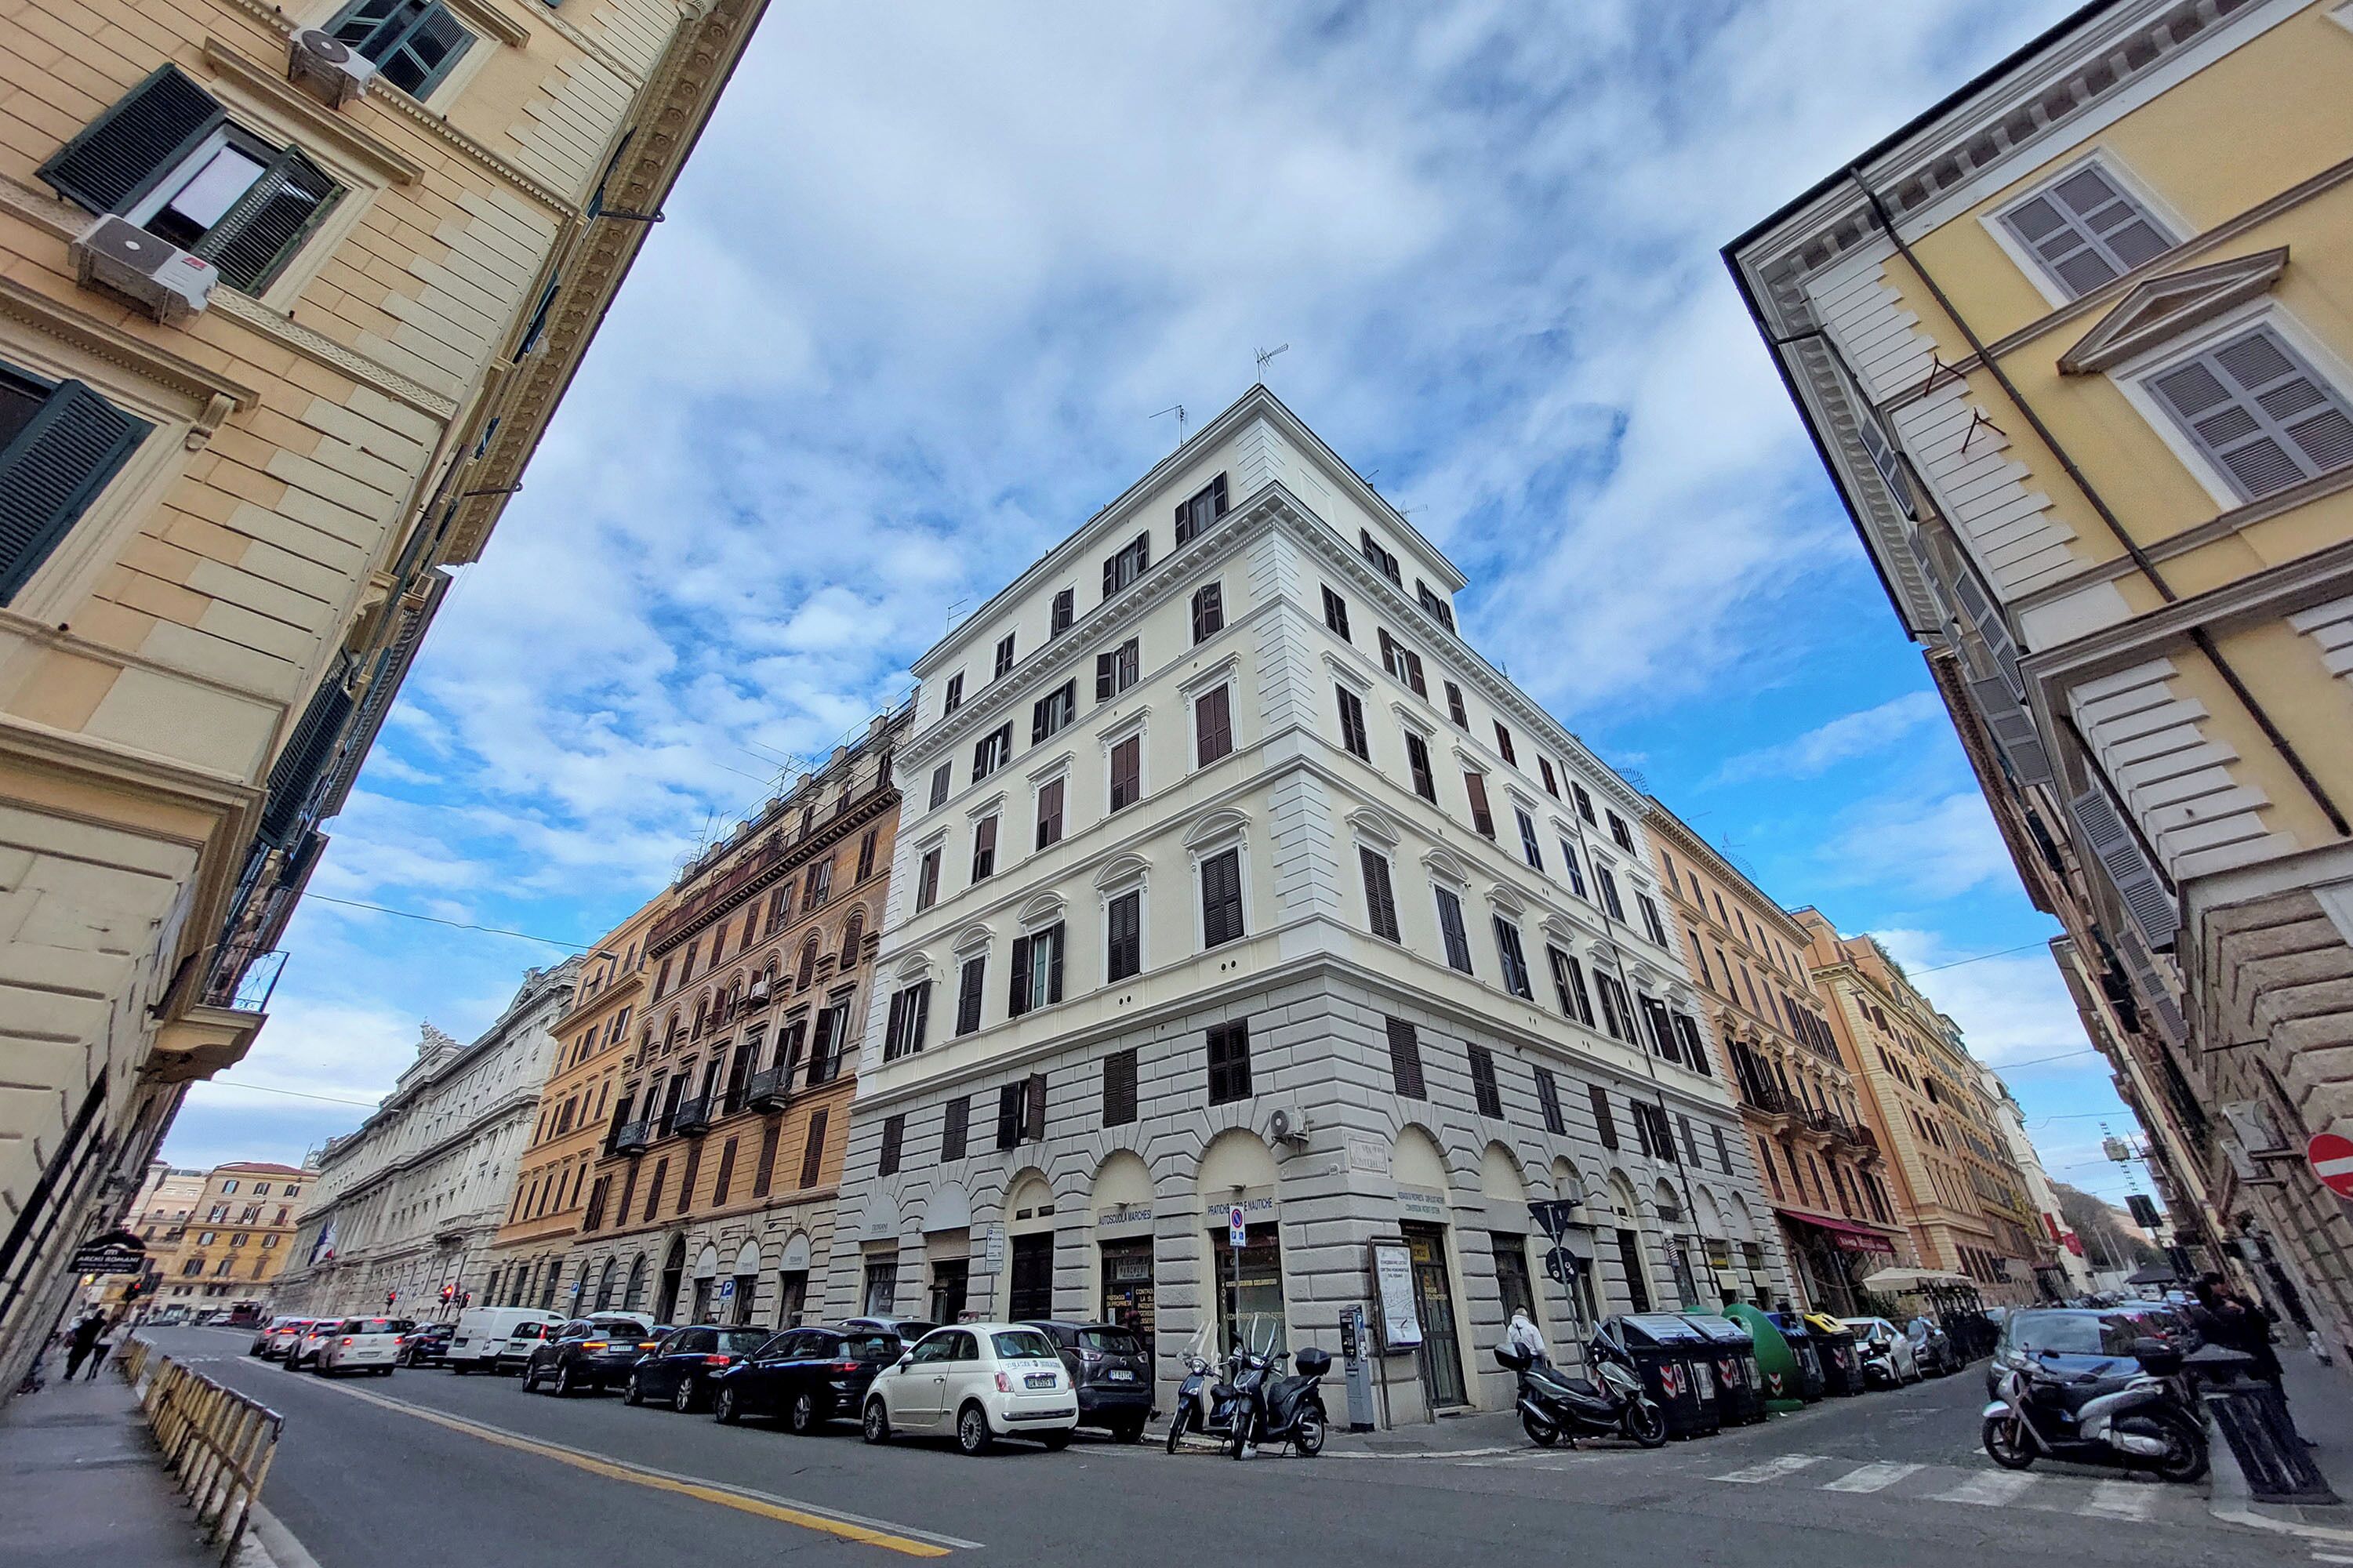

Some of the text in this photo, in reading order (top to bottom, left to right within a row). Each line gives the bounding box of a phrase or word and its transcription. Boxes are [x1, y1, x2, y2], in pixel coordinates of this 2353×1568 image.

[1248, 1197, 1273, 1211] NAUTICHE
[1098, 1209, 1151, 1225] AUTOSCUOLA MARCHESI
[723, 1282, 733, 1294] P
